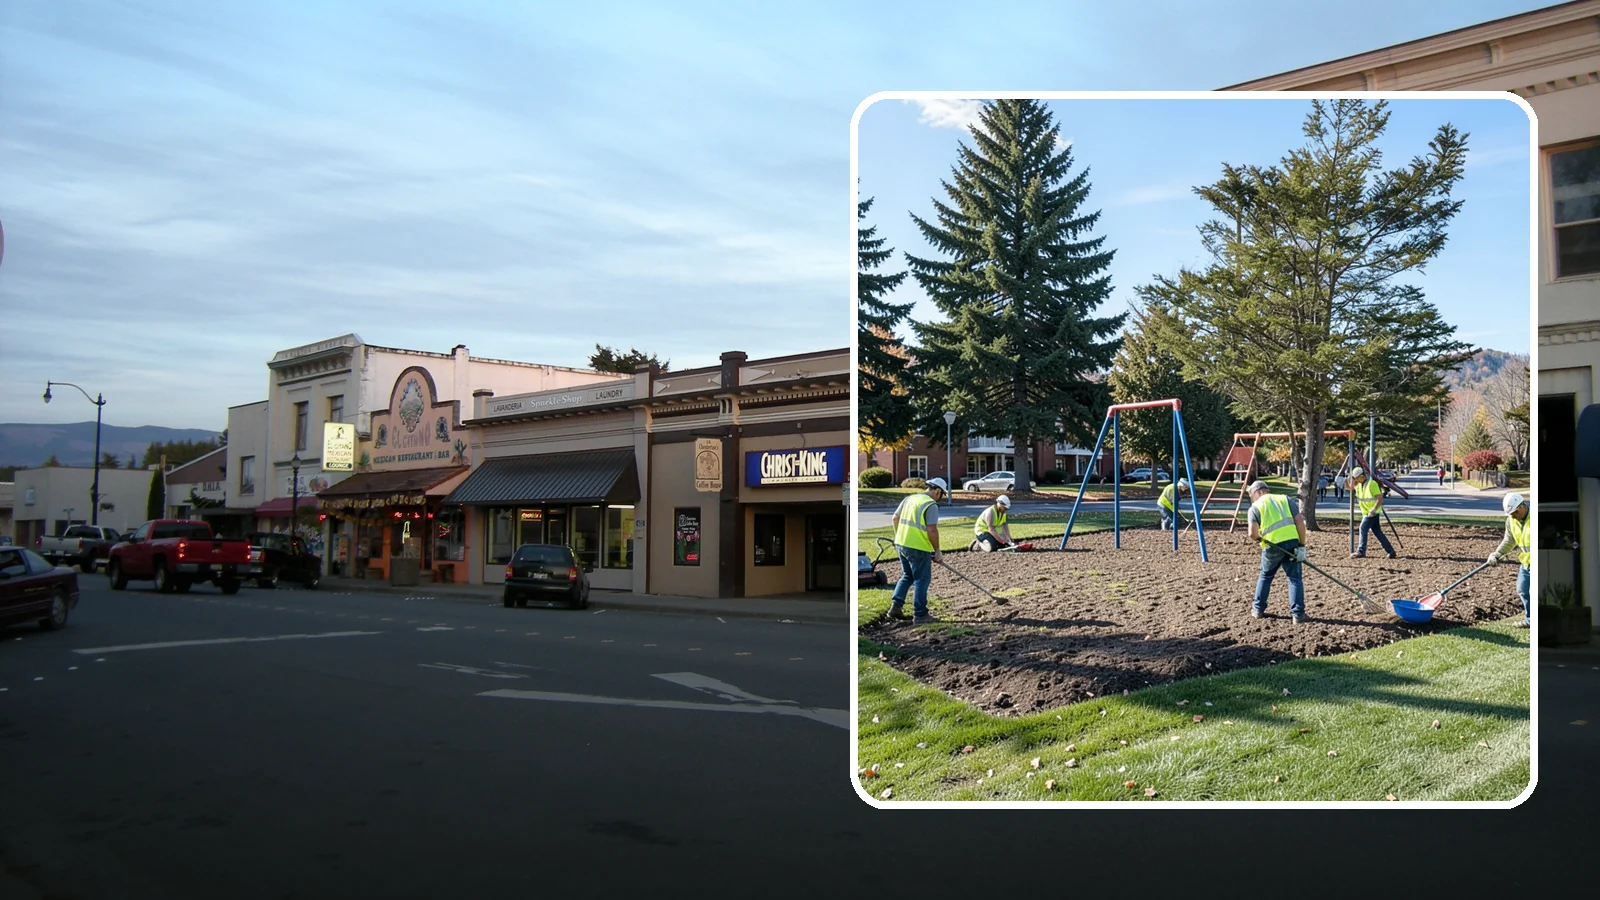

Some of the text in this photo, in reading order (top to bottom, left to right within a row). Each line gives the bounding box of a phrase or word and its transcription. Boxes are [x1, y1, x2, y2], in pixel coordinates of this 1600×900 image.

[530, 394, 583, 409] Sparkle Shop
[595, 389, 624, 400] LAUNDRY
[493, 401, 523, 413] LAVANDERIA
[373, 455, 396, 464] MEXICAN
[397, 451, 433, 462] RESTAURANT
[437, 450, 450, 459] BAR
[760, 450, 827, 478] CHRIST KING
